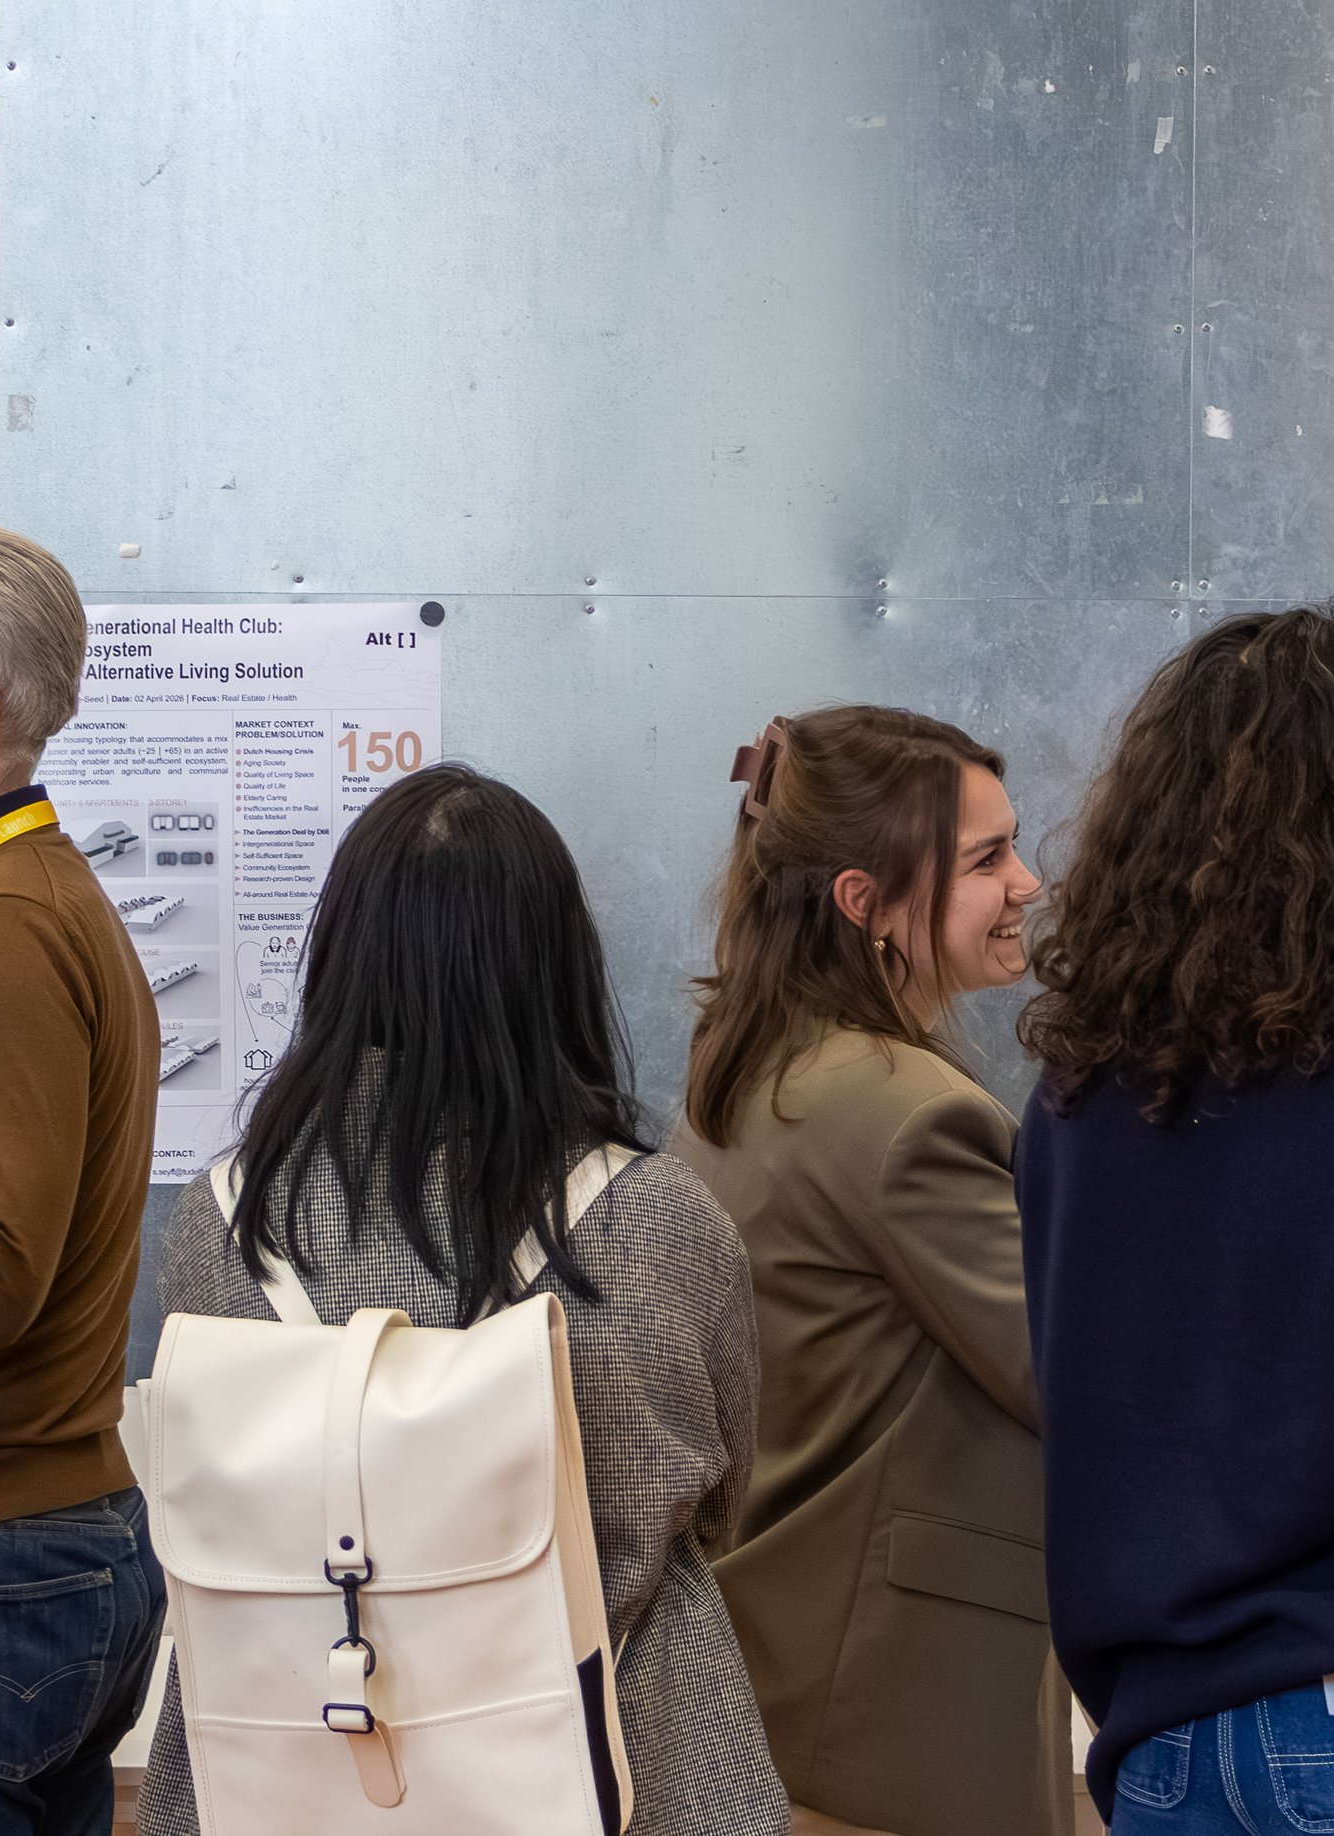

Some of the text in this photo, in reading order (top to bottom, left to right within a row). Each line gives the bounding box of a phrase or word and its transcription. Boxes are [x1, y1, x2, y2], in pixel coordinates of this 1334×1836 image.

[87, 618, 283, 634] enerational Health Club:
[365, 632, 392, 646] Alt
[85, 642, 152, 661] osystem
[85, 663, 304, 682] Alternative Living Solution
[84, 695, 104, 703] Seed
[111, 695, 133, 703] Date:
[134, 695, 144, 703] 02
[146, 695, 163, 704] April
[165, 695, 184, 703] 2026
[191, 694, 219, 703] Focus:
[222, 694, 240, 702] Real
[241, 694, 266, 702] Estate
[272, 694, 297, 702] Health
[74, 722, 128, 730] INNOVATION:
[274, 720, 315, 728] CONTEXT
[342, 722, 362, 730] Max.
[64, 736, 93, 744] housing
[95, 736, 127, 745] typology
[265, 748, 293, 756] Housing
[337, 730, 423, 773] 150
[131, 757, 182, 765] self-sufficient
[185, 757, 228, 766] ecosystem,
[243, 760, 262, 768] Aging
[121, 768, 161, 776] agriculture
[188, 767, 228, 775] communal
[243, 771, 265, 779] Quality
[274, 771, 293, 779] Living
[294, 771, 315, 779] Space
[342, 775, 370, 784] People
[243, 783, 265, 791] Quality
[243, 794, 287, 802] Elderly Caring
[242, 864, 311, 872] Community Ecosystem
[294, 875, 316, 883] Design
[238, 913, 304, 921] THE BUSINESS:
[238, 923, 260, 931] Value
[262, 923, 304, 931] Generation
[152, 1150, 196, 1158] CONTACT:
